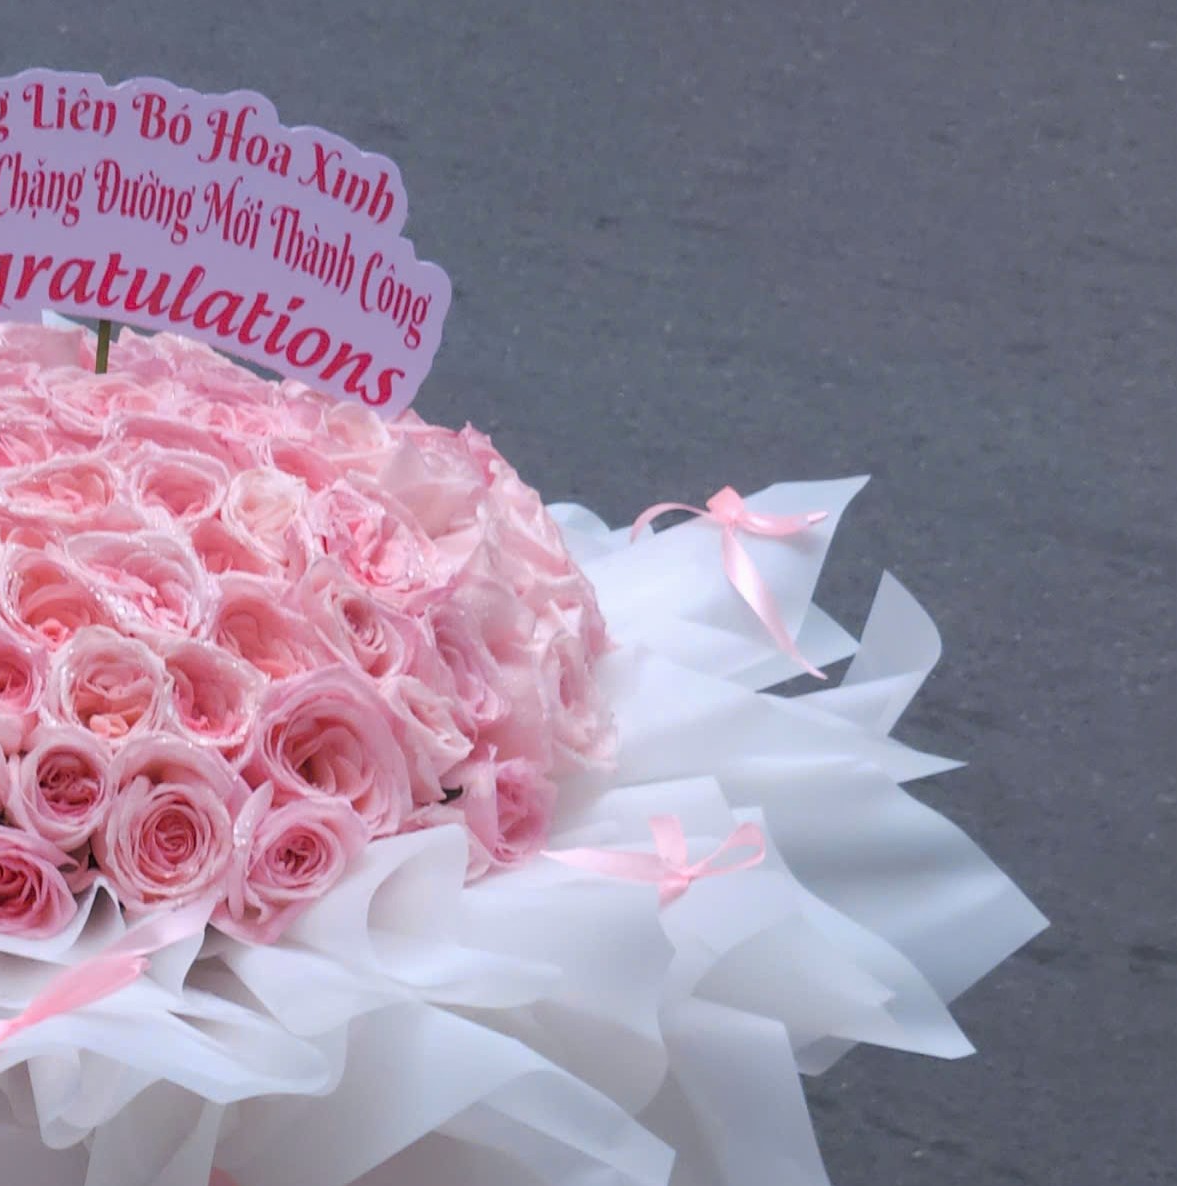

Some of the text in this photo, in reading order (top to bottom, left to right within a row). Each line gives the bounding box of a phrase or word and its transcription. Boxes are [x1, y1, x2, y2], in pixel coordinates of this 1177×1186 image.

[20, 81, 119, 138] Liên
[130, 91, 194, 147] Bó
[196, 104, 292, 179] Hoa
[92, 156, 197, 246] Đường
[196, 175, 265, 252] Mới
[269, 204, 356, 296] Thành
[358, 251, 432, 350] Công
